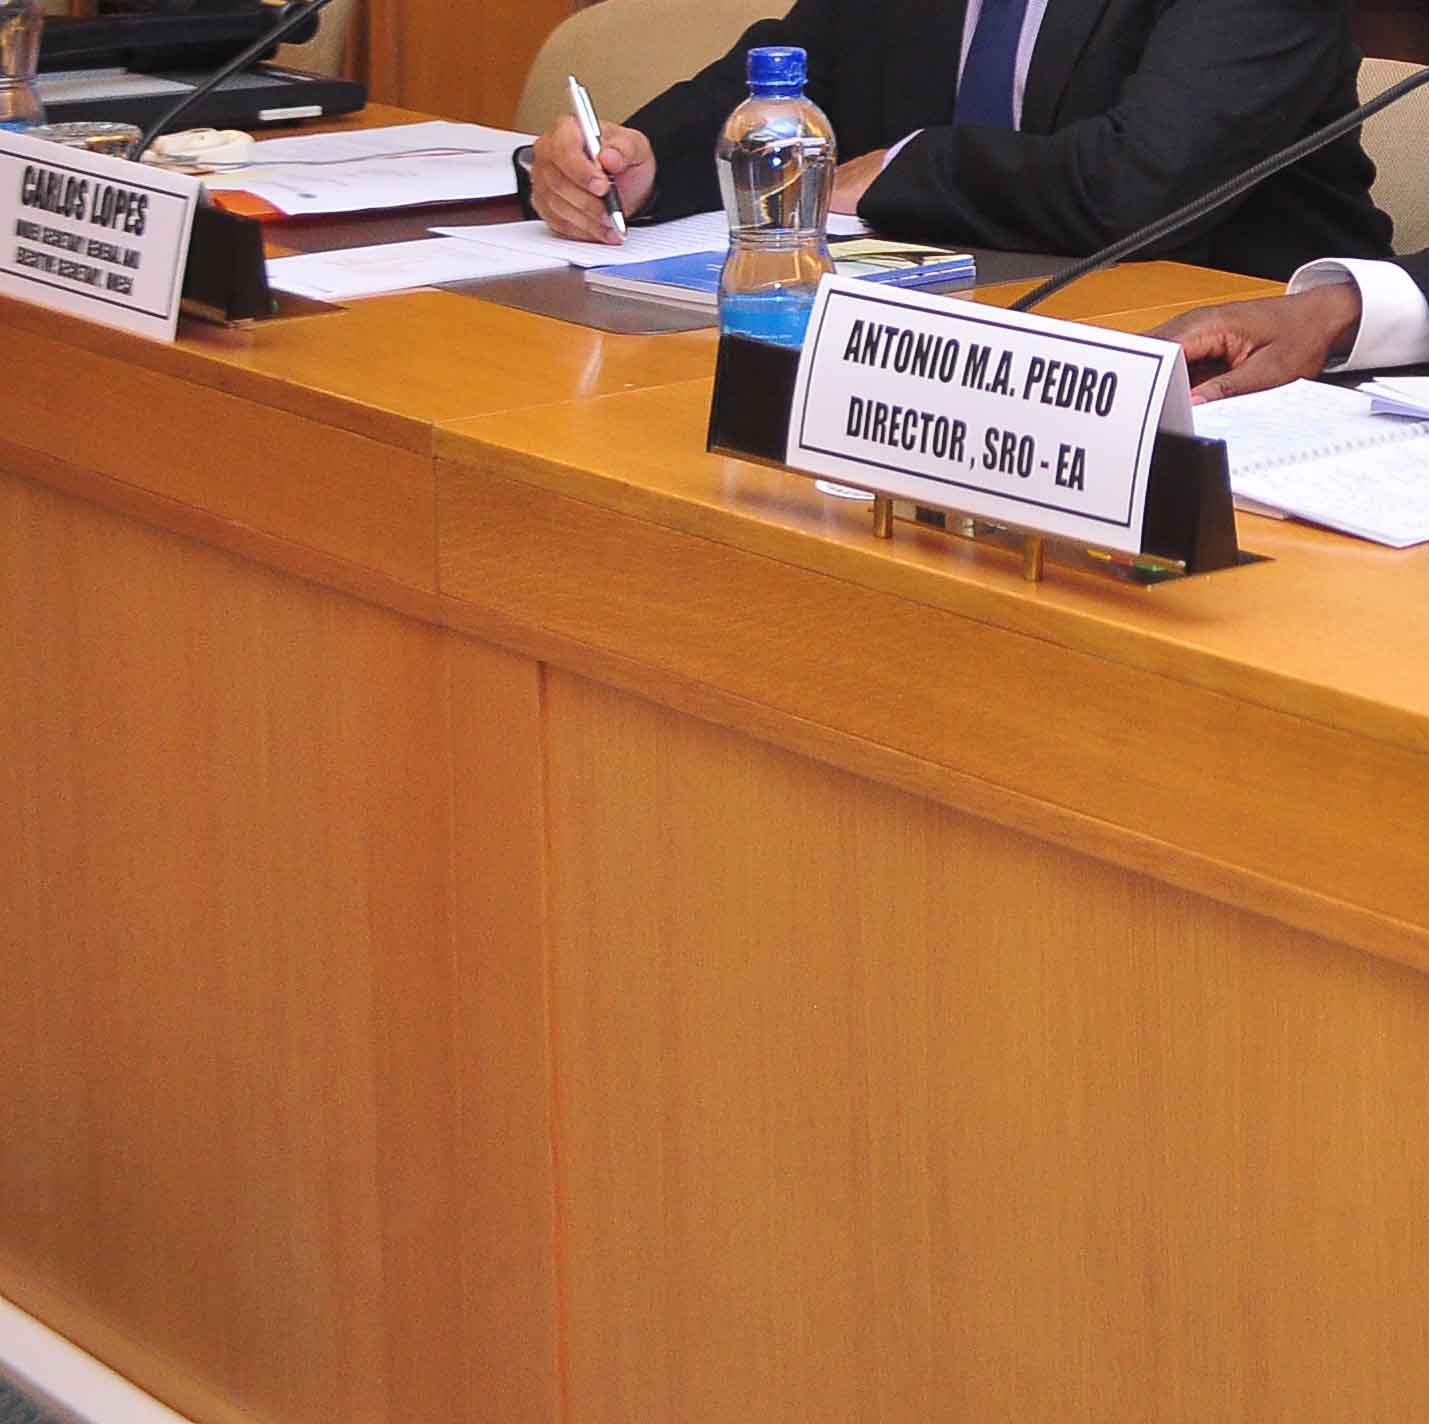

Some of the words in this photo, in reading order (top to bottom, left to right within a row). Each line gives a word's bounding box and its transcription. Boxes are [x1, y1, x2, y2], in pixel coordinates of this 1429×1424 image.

[21, 164, 89, 221] CARLOS
[89, 183, 149, 236] LOPES
[843, 319, 960, 384] ANTONIO
[961, 343, 1014, 396] M.A.
[1022, 356, 1118, 417] PEDRO
[982, 426, 1035, 479] SRO
[1054, 443, 1086, 491] EA
